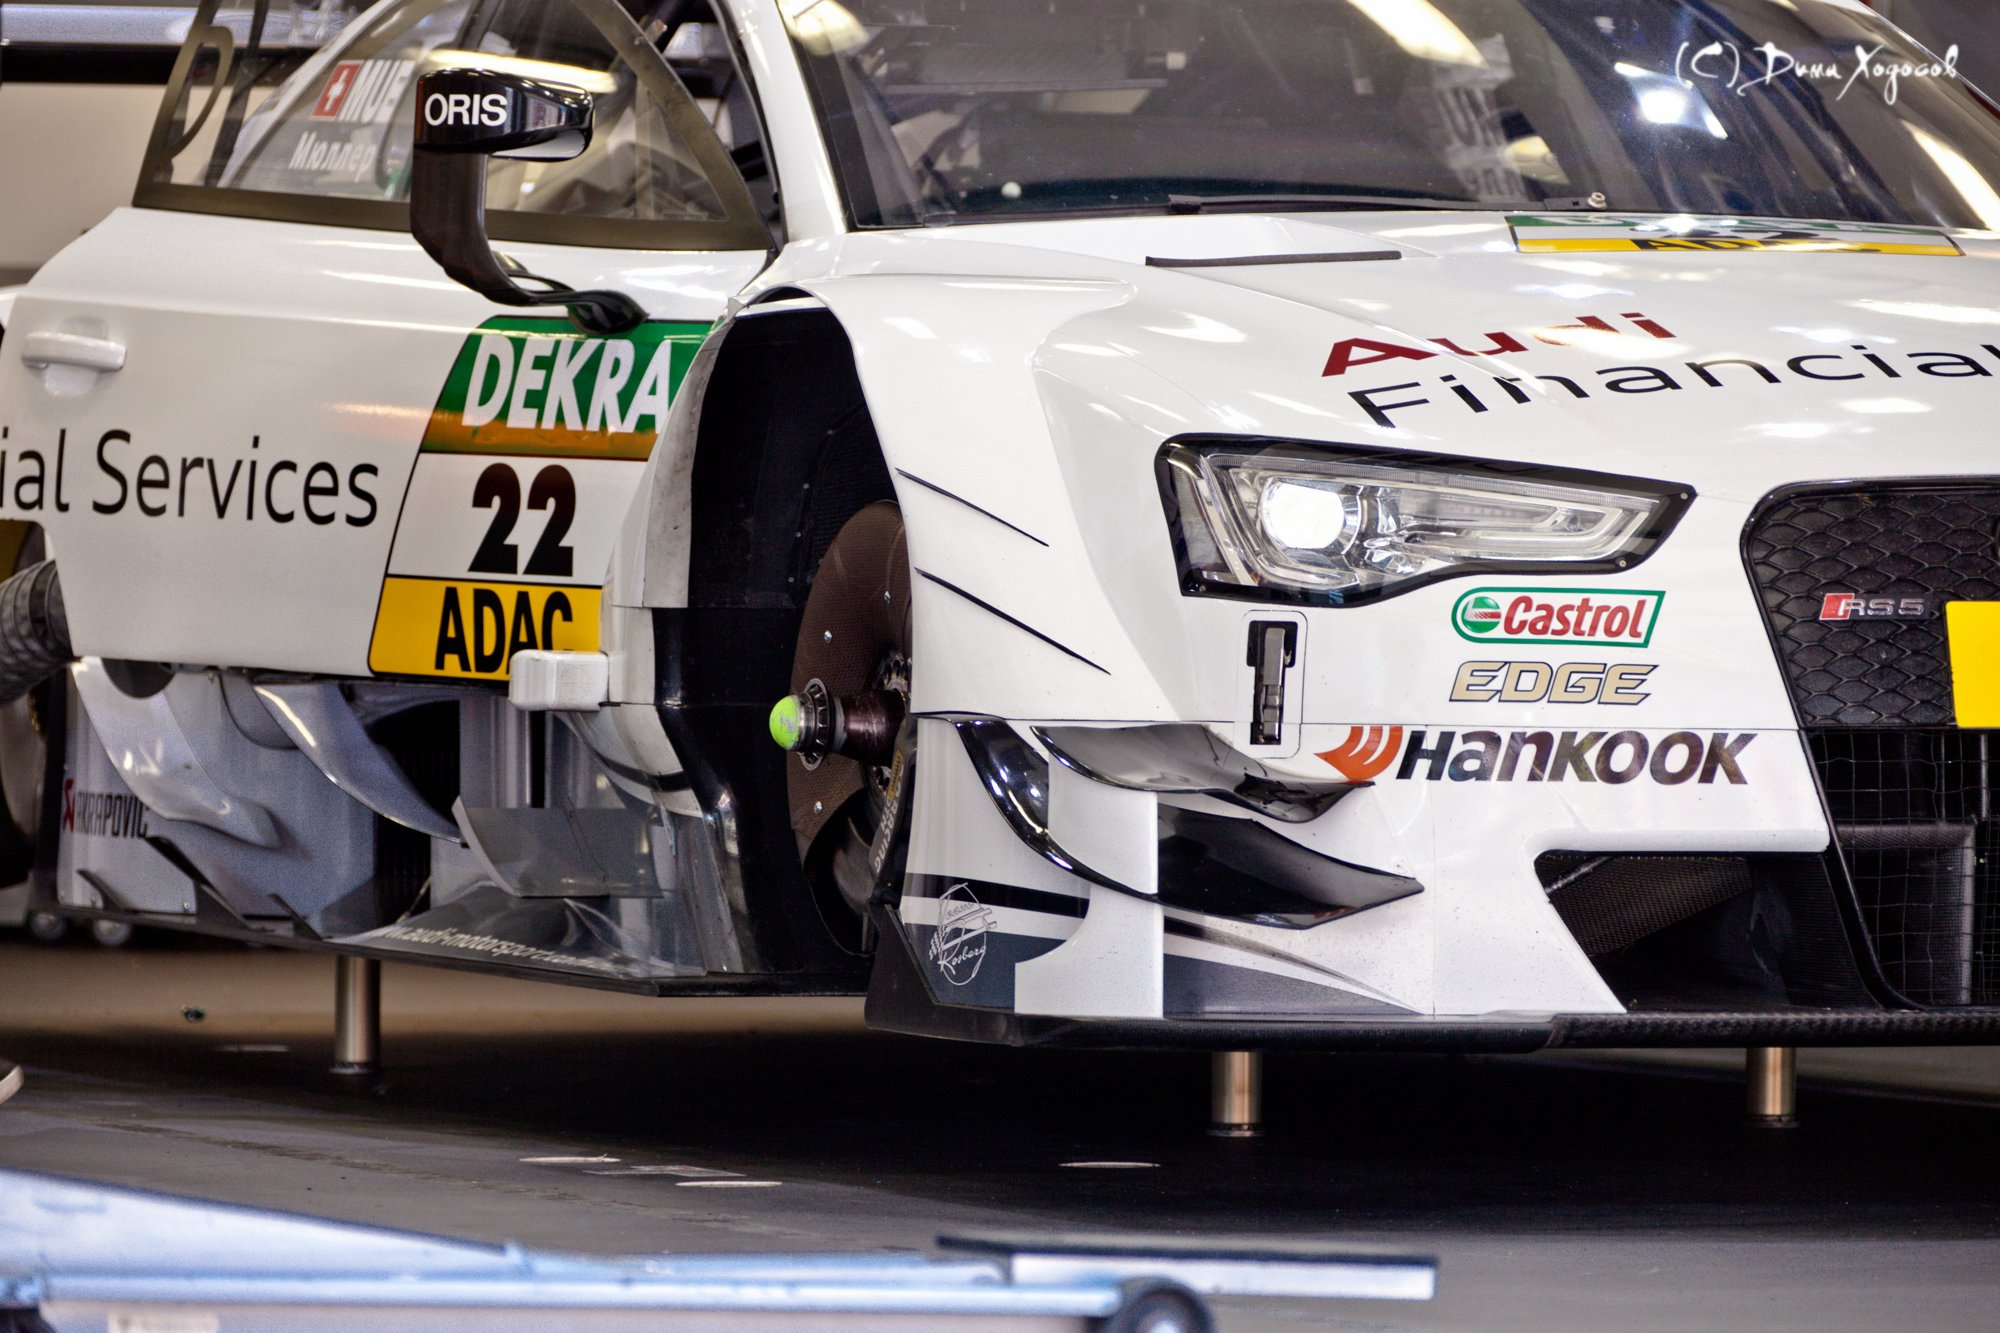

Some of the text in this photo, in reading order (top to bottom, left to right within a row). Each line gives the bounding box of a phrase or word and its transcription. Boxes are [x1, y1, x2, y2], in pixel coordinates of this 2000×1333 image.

[424, 92, 509, 127] ORIS
[462, 334, 672, 434] DEKRA
[92, 428, 379, 528] Services
[468, 462, 577, 577] 22
[435, 586, 574, 675] ADAC
[1503, 595, 1648, 639] Castrol
[1449, 660, 1660, 706] EDGE
